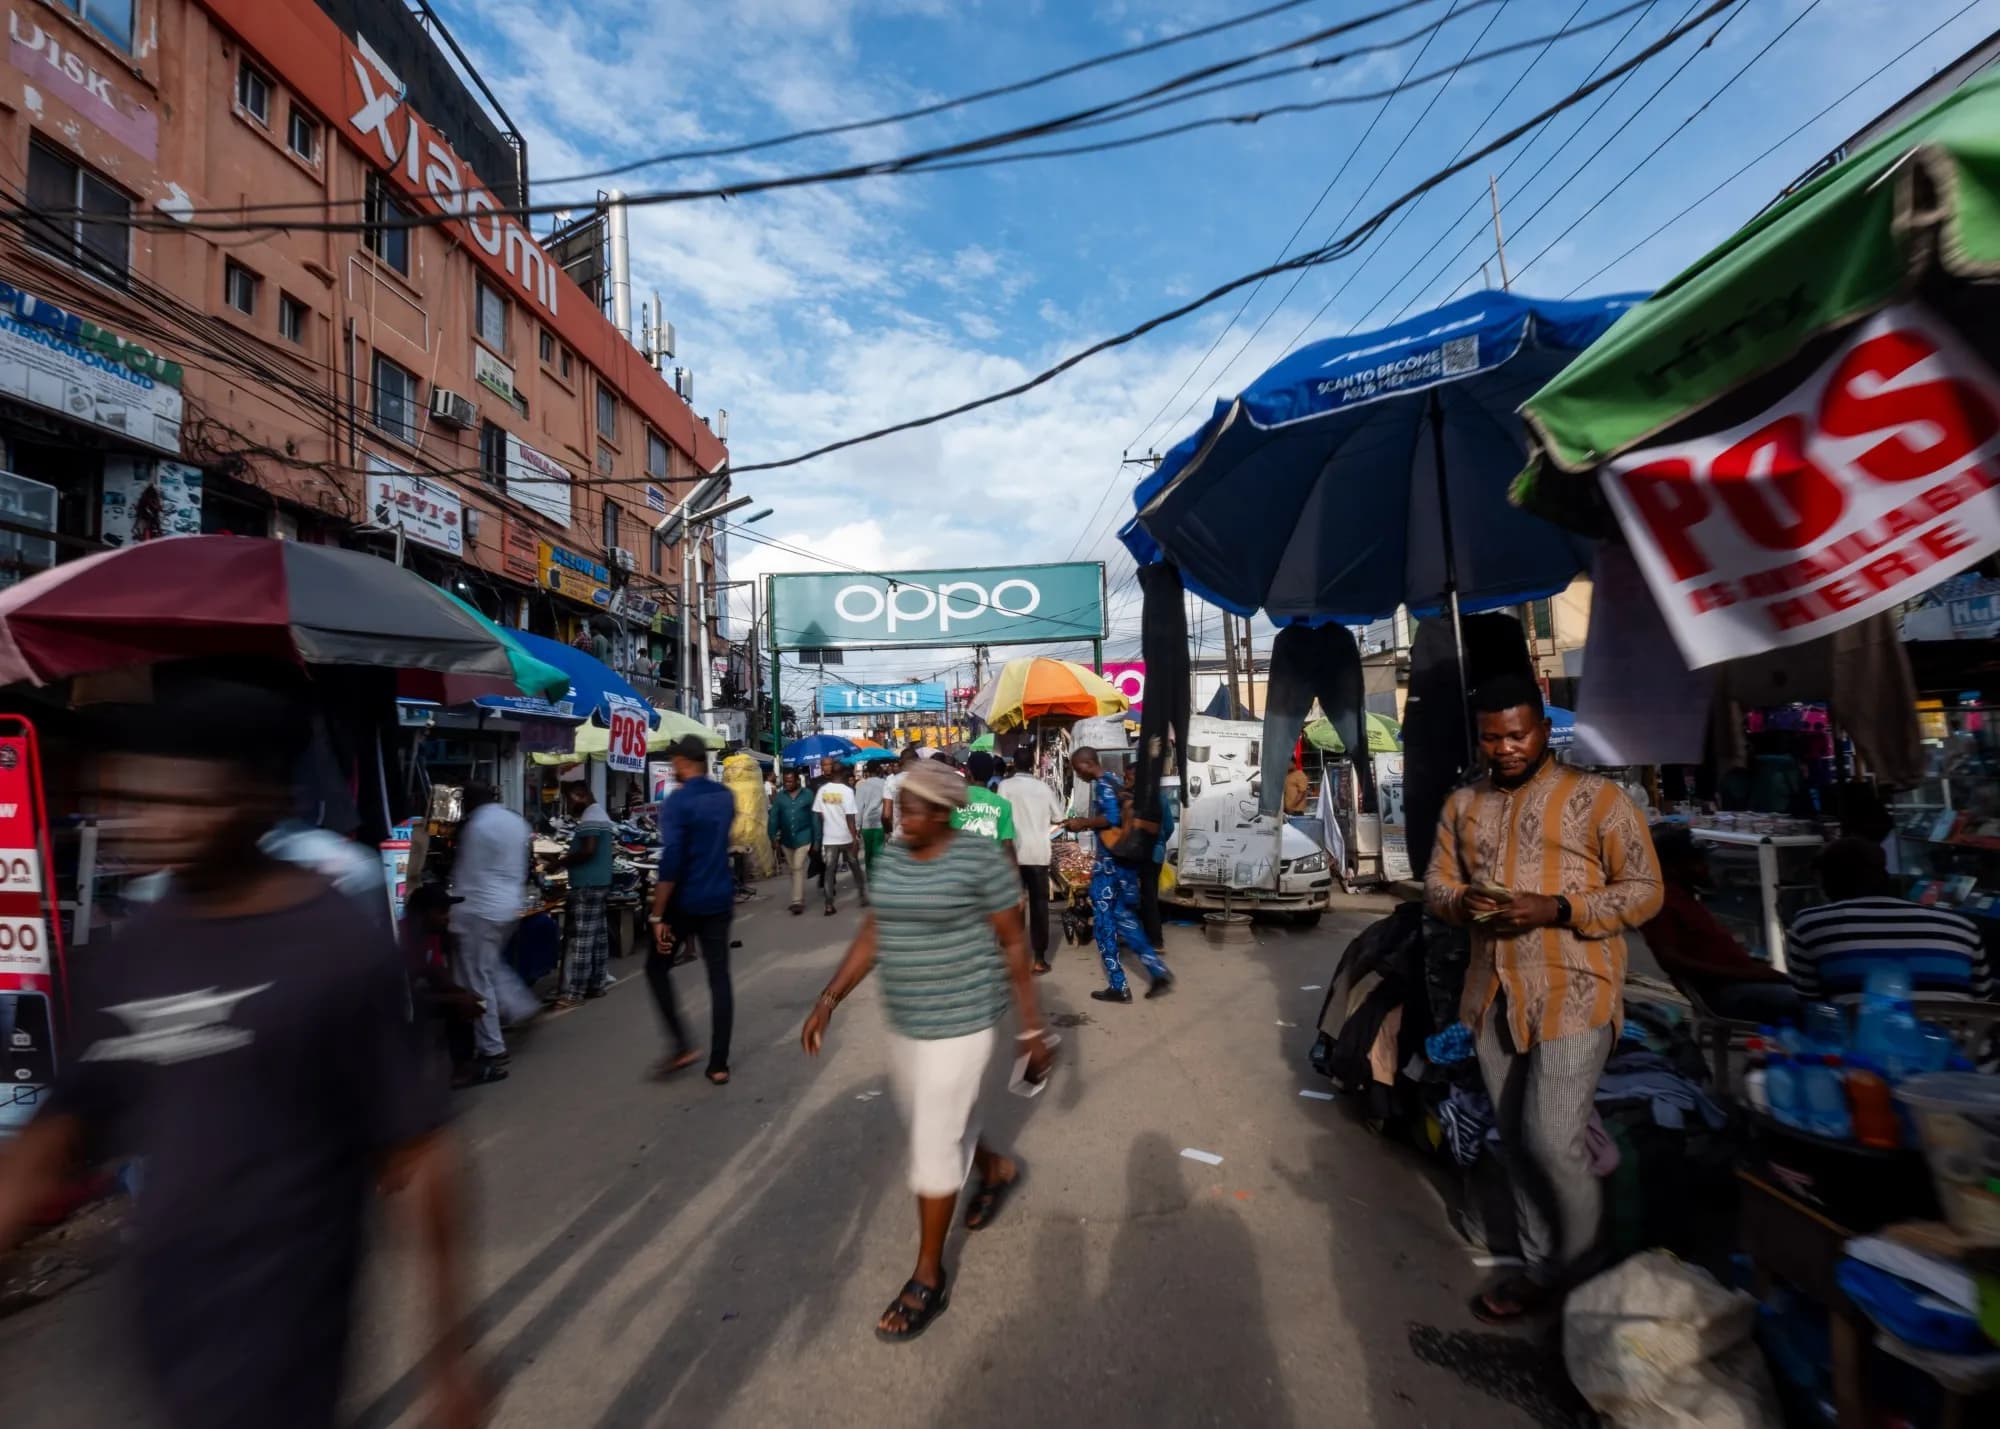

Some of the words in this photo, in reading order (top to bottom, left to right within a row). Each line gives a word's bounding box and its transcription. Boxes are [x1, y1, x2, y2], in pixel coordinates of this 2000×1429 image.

[1317, 374, 1353, 395] SCAN
[1355, 368, 1375, 385] TO
[1376, 349, 1442, 381] BECOME
[1342, 381, 1376, 403] ASUS
[1377, 363, 1442, 392] MEMBER
[1618, 327, 2000, 584] POS
[1766, 518, 1981, 632] HERE
[834, 578, 1041, 633] oppo
[841, 689, 918, 707] TECNO
[609, 714, 647, 758] POS
[609, 753, 616, 763] IS
[616, 755, 642, 767] AVAILABLE
